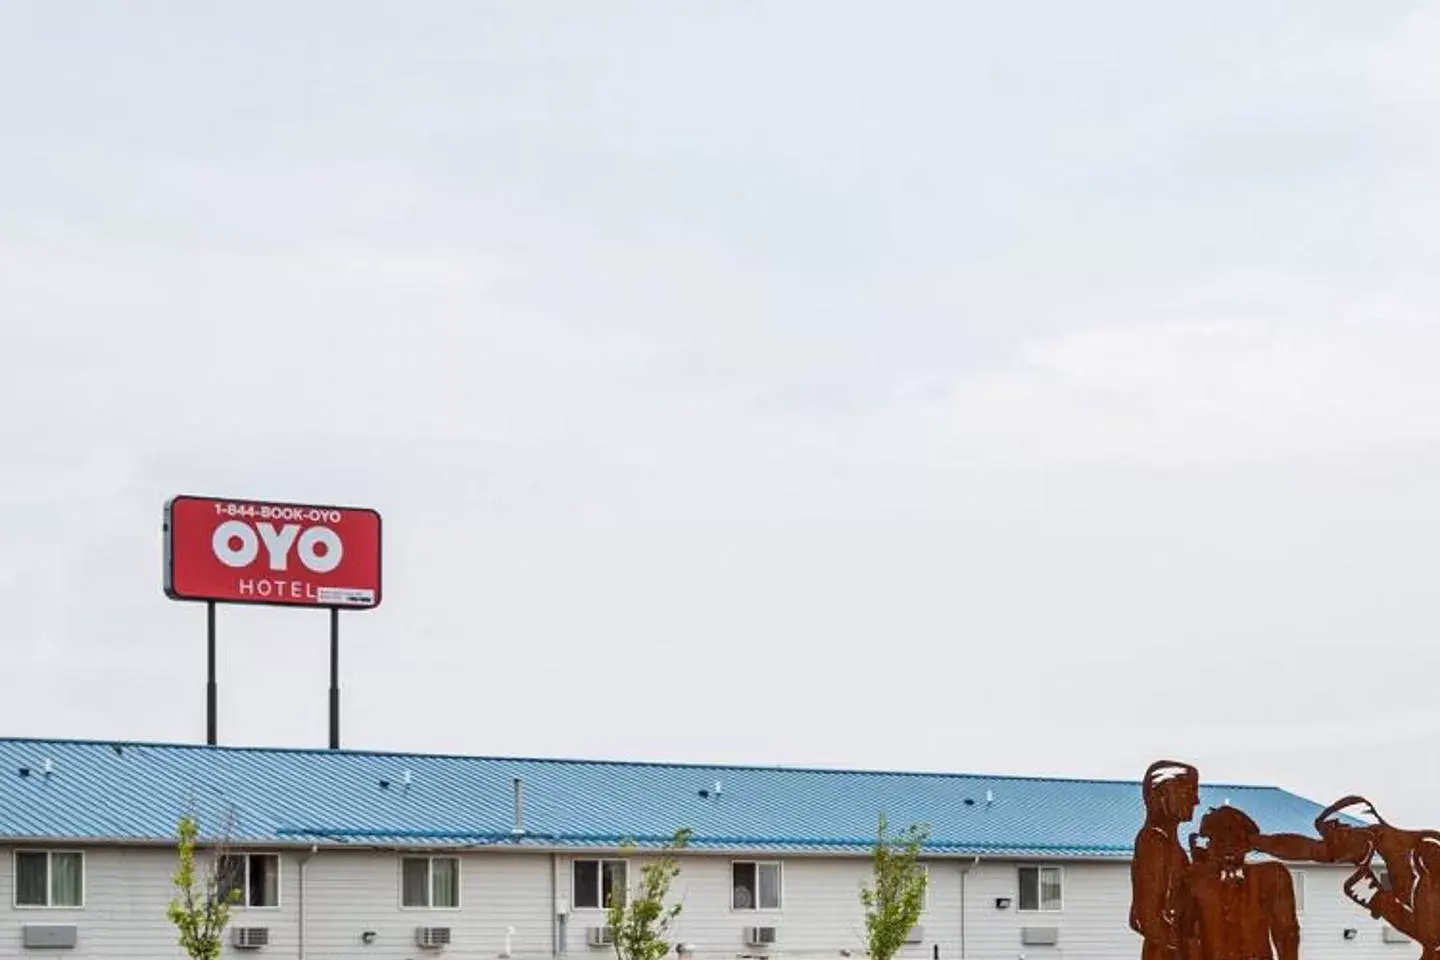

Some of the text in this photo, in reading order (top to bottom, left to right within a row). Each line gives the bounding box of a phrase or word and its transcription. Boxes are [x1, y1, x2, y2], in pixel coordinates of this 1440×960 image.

[214, 503, 341, 523] 1-844-BOOK-OYO
[212, 520, 344, 573] OYO
[239, 578, 317, 599] HOTEL
